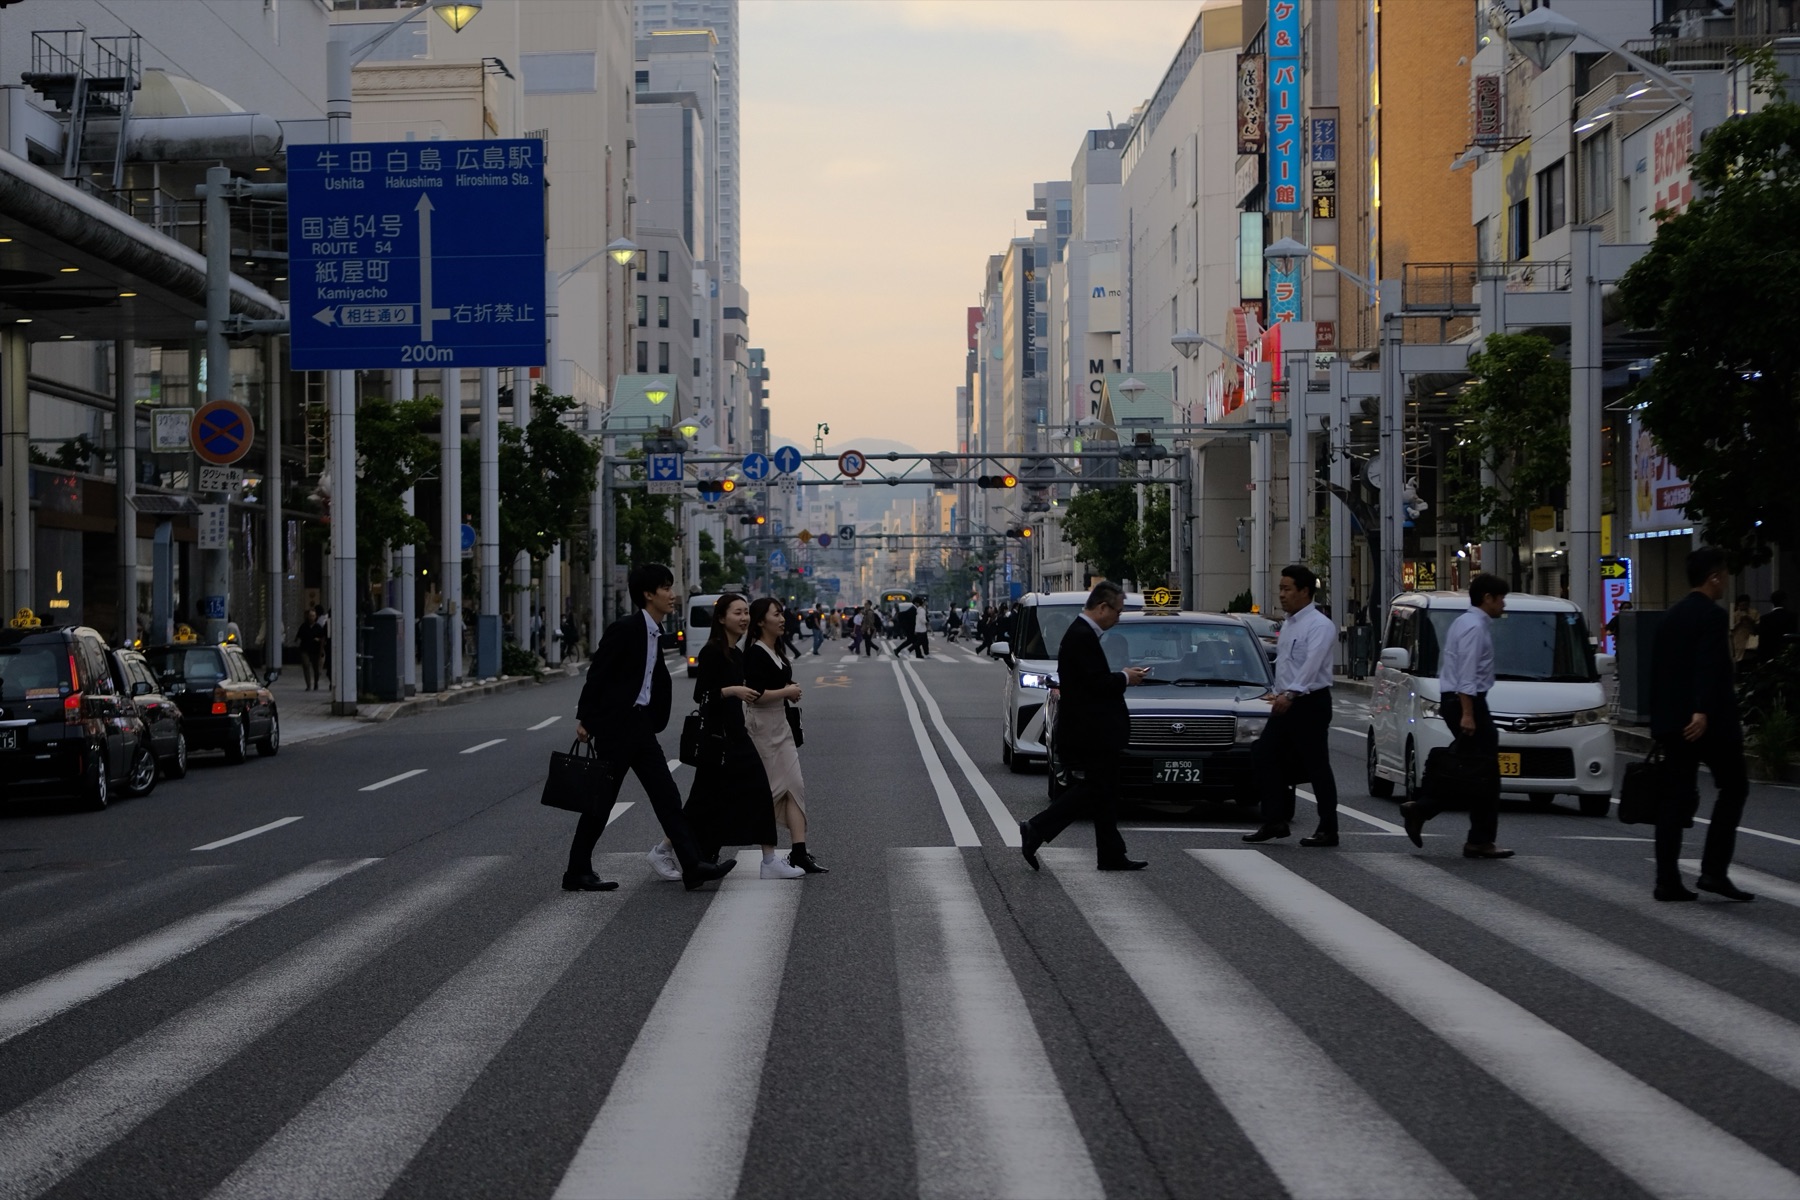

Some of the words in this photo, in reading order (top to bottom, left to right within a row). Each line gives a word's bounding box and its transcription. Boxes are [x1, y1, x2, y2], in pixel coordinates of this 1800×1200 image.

[317, 150, 372, 174] 牛田
[387, 147, 442, 173] 白島
[456, 145, 533, 170] 広島駅
[325, 177, 365, 191] Ushita
[385, 175, 443, 189] Hakushima
[456, 173, 508, 187] Hiroshima
[511, 172, 533, 186] Sta.
[301, 214, 404, 240] 国道54号
[311, 241, 358, 255] ROUTE
[374, 240, 393, 254] 54
[315, 259, 390, 284] 紙屋町
[317, 286, 388, 302] Kamiyacho
[347, 308, 407, 323] 相生通り
[453, 303, 536, 324] 右折禁止
[400, 345, 454, 363] 200m
[201, 480, 240, 491] ここまで
[1158, 592, 1166, 603] F
[1164, 768, 1201, 782] 77-32
